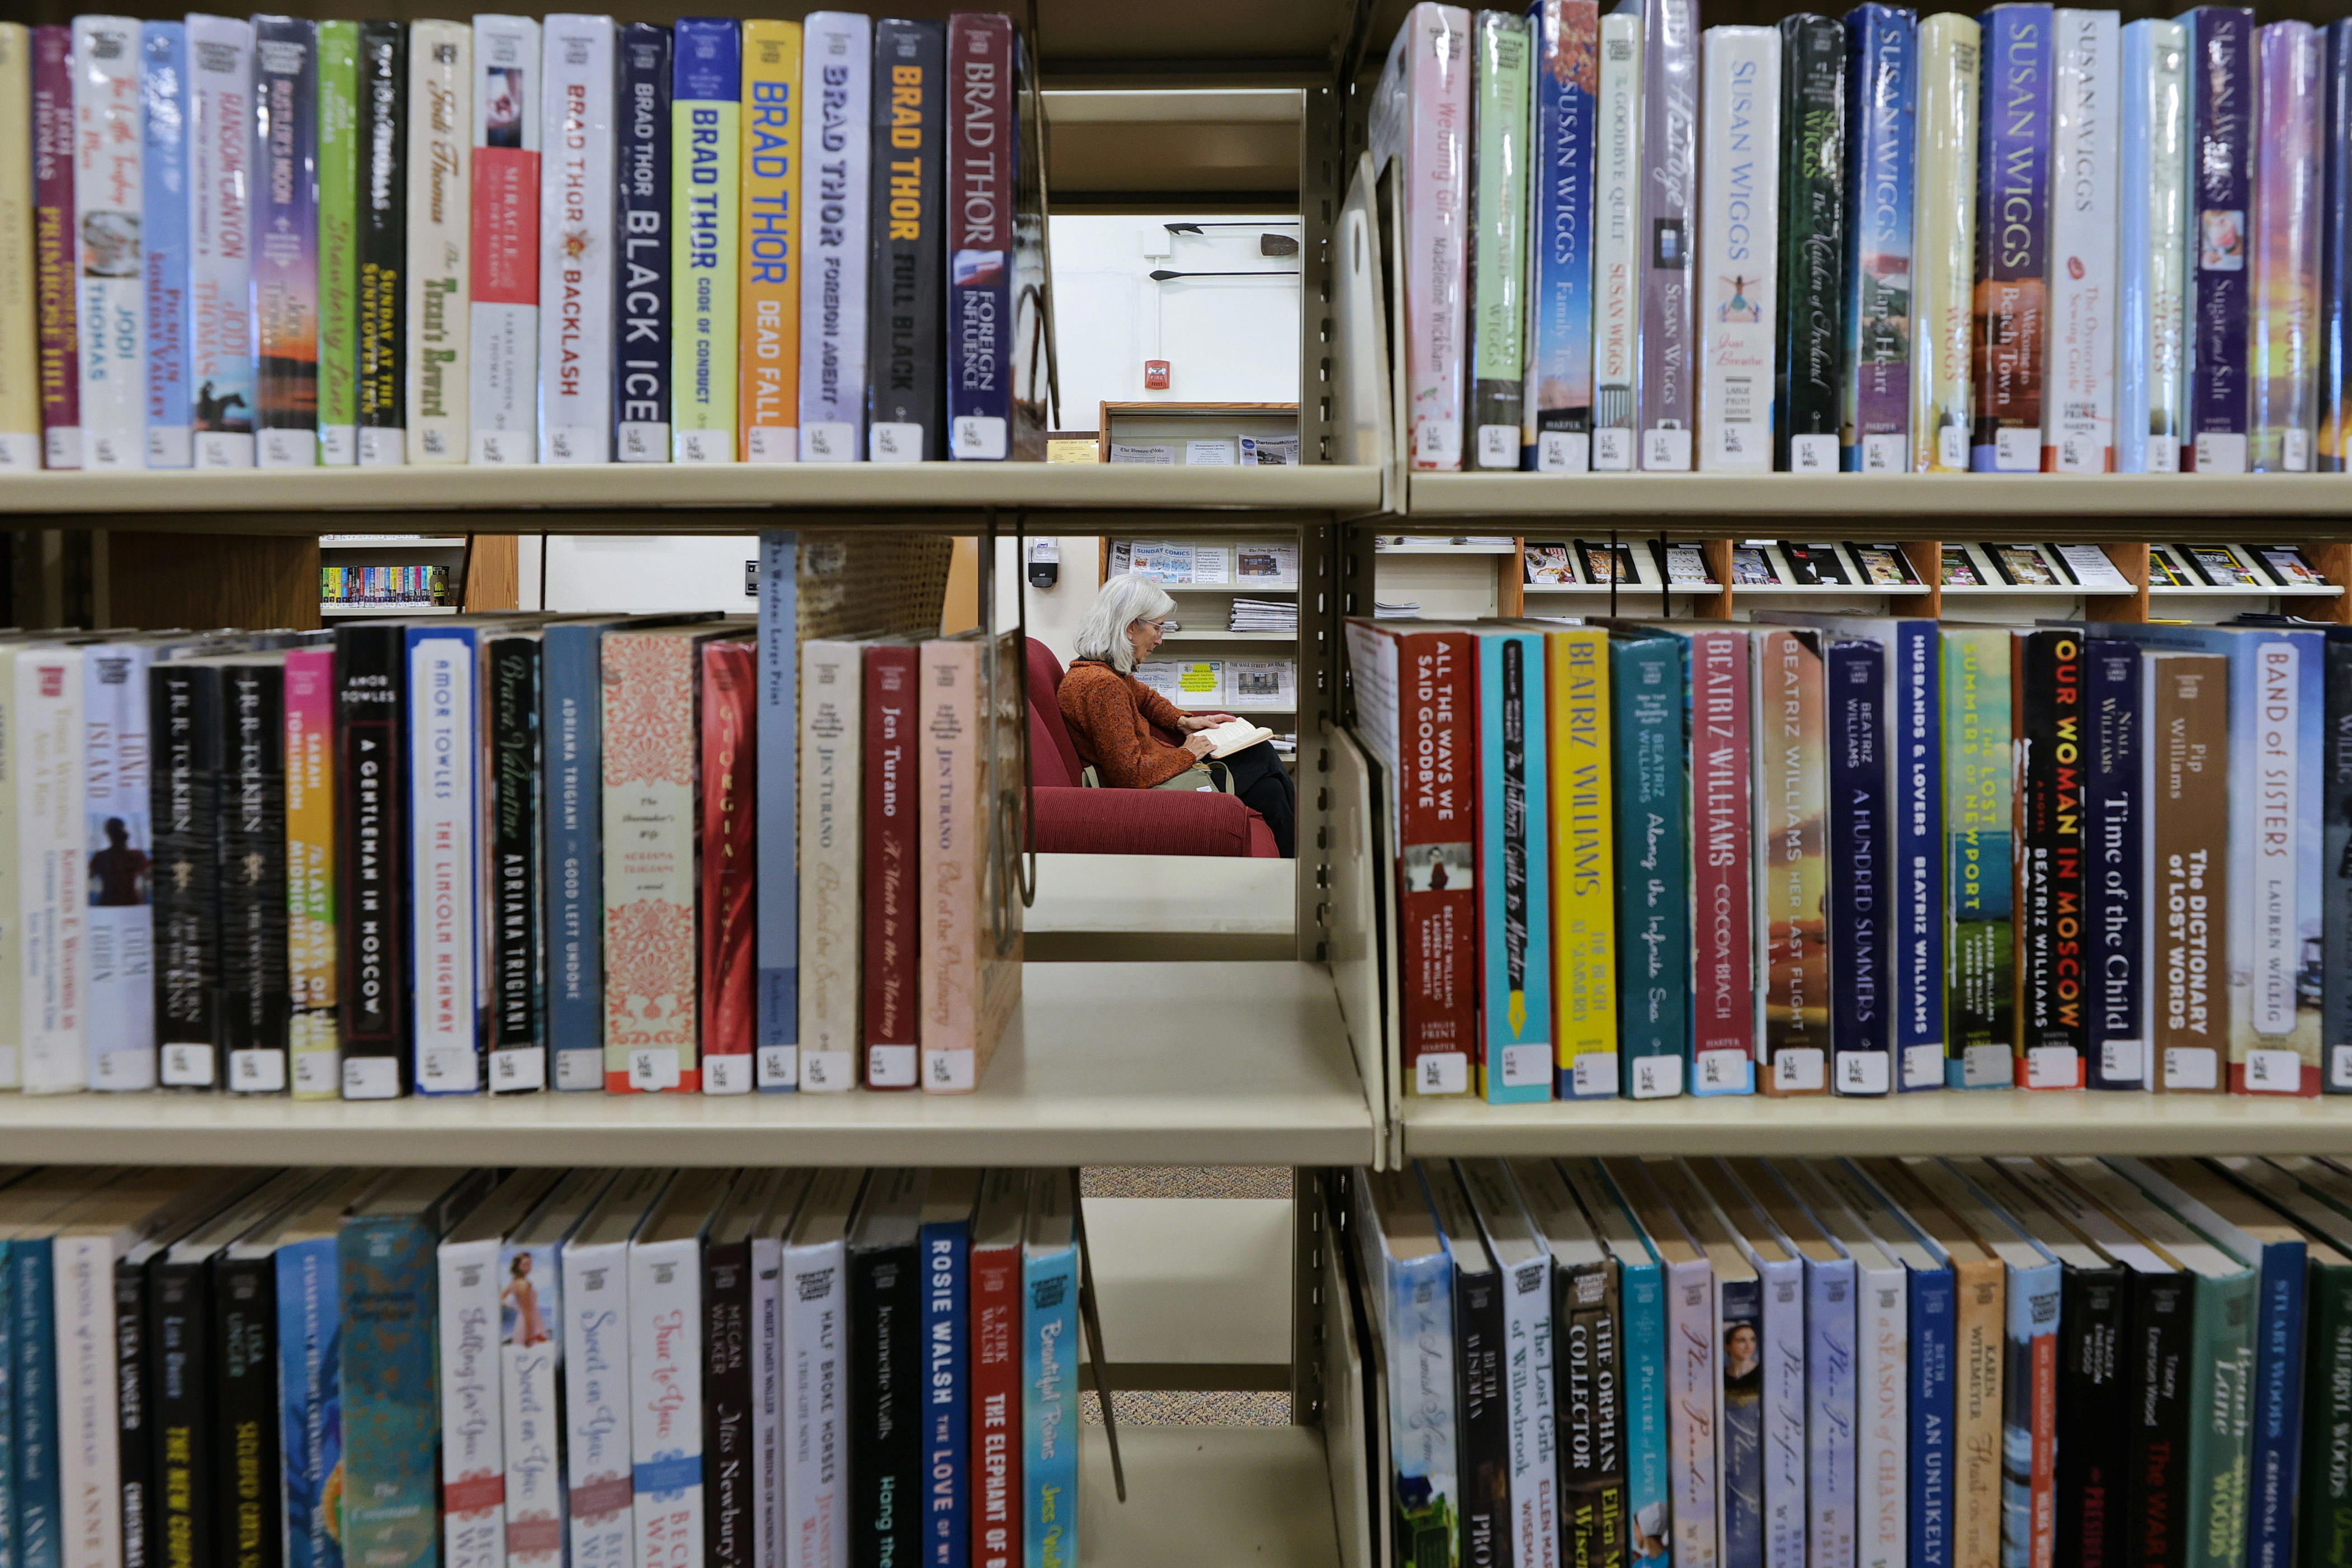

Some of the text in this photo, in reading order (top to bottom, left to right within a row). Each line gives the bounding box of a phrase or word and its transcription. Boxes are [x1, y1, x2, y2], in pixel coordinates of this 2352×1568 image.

[965, 62, 995, 244] BRAD THOR
[1557, 83, 1578, 168] SUSAN
[1728, 60, 1756, 260] SUSAN WIGGS
[2002, 25, 2037, 267] SUSAN WIGGS
[560, 84, 585, 396] BRAD THOR BACKLASH
[626, 83, 660, 421] BRAD THOR BLACK ICE
[692, 109, 717, 404] BRAD THOR CODE OF CONDUCT
[752, 81, 788, 423] BRAD THOR DEAD FALL
[1555, 176, 1577, 264] WIGGS
[1608, 92, 1628, 376] GOODBYE QUILT SUSAN WIGGS
[88, 284, 106, 380] THOMAS
[115, 306, 136, 359] JODI
[963, 291, 979, 390] INFLUENCE
[980, 292, 994, 390] FOREIGN
[1997, 287, 2020, 403] Beach Town
[2021, 308, 2035, 383] Welcome to
[1546, 421, 1581, 429] HARPER
[882, 706, 901, 815] Jen Turano
[1419, 655, 1433, 808] SAID GOODBYE
[1435, 642, 1454, 820] ALL THE WAYS WE
[1570, 642, 1601, 898] BEATRIZ WILLIAMS
[1964, 643, 1981, 909] SUMMERS OF NEWPORT
[1982, 727, 1996, 825] THE LOST
[361, 739, 379, 1013] A GENTLEMAN IN MOSCOW
[434, 660, 452, 1033] AMOR TOWLES THE LINCOLN HIGHWAY
[563, 698, 580, 998] ADRIANA TRIGIANI GOOD LEFT UNDONE
[1640, 814, 1668, 1023] Along the Infinite Sea
[1707, 640, 1735, 1019] BEATRIZ WILLIAMS COCOA BEACH
[1784, 639, 1803, 1031] BEATRIZ WILLIAMS HER LAST FLIGHT
[1854, 790, 1873, 1022] A HUNDRED SUMMERS
[1912, 635, 1928, 1033] HUSBANDS & LOVERS BEATRIZ WILLIAMS
[2055, 640, 2079, 1028] OUR WOMAN IN MOSCOW
[2104, 791, 2128, 1029] Time of the Child
[2266, 653, 2290, 1022] BAND of SISTERS LAUREN WILLIG
[2034, 847, 2048, 1027] BEATRIZ WILLIAMS
[2168, 854, 2185, 1029] of LOST WORDS
[2189, 849, 2207, 1033] The DICTIONARY
[820, 1311, 836, 1485] HALF BROKE HORSES
[933, 1240, 952, 1566] ROSIE WALSH THE LOVE OF MY
[1512, 1321, 1529, 1476] of Willowbrook
[1535, 1317, 1555, 1462] The Lost Girls
[1570, 1325, 1593, 1468] COLLECTOR
[1597, 1315, 1616, 1472] THE ORPHAN
[1877, 1333, 1896, 1420] SEASON
[986, 1394, 1007, 1552] THE ELEPHANT OF
[1878, 1449, 1897, 1546] CHANGE
[1926, 1415, 1943, 1566] AN UNLIKELY
